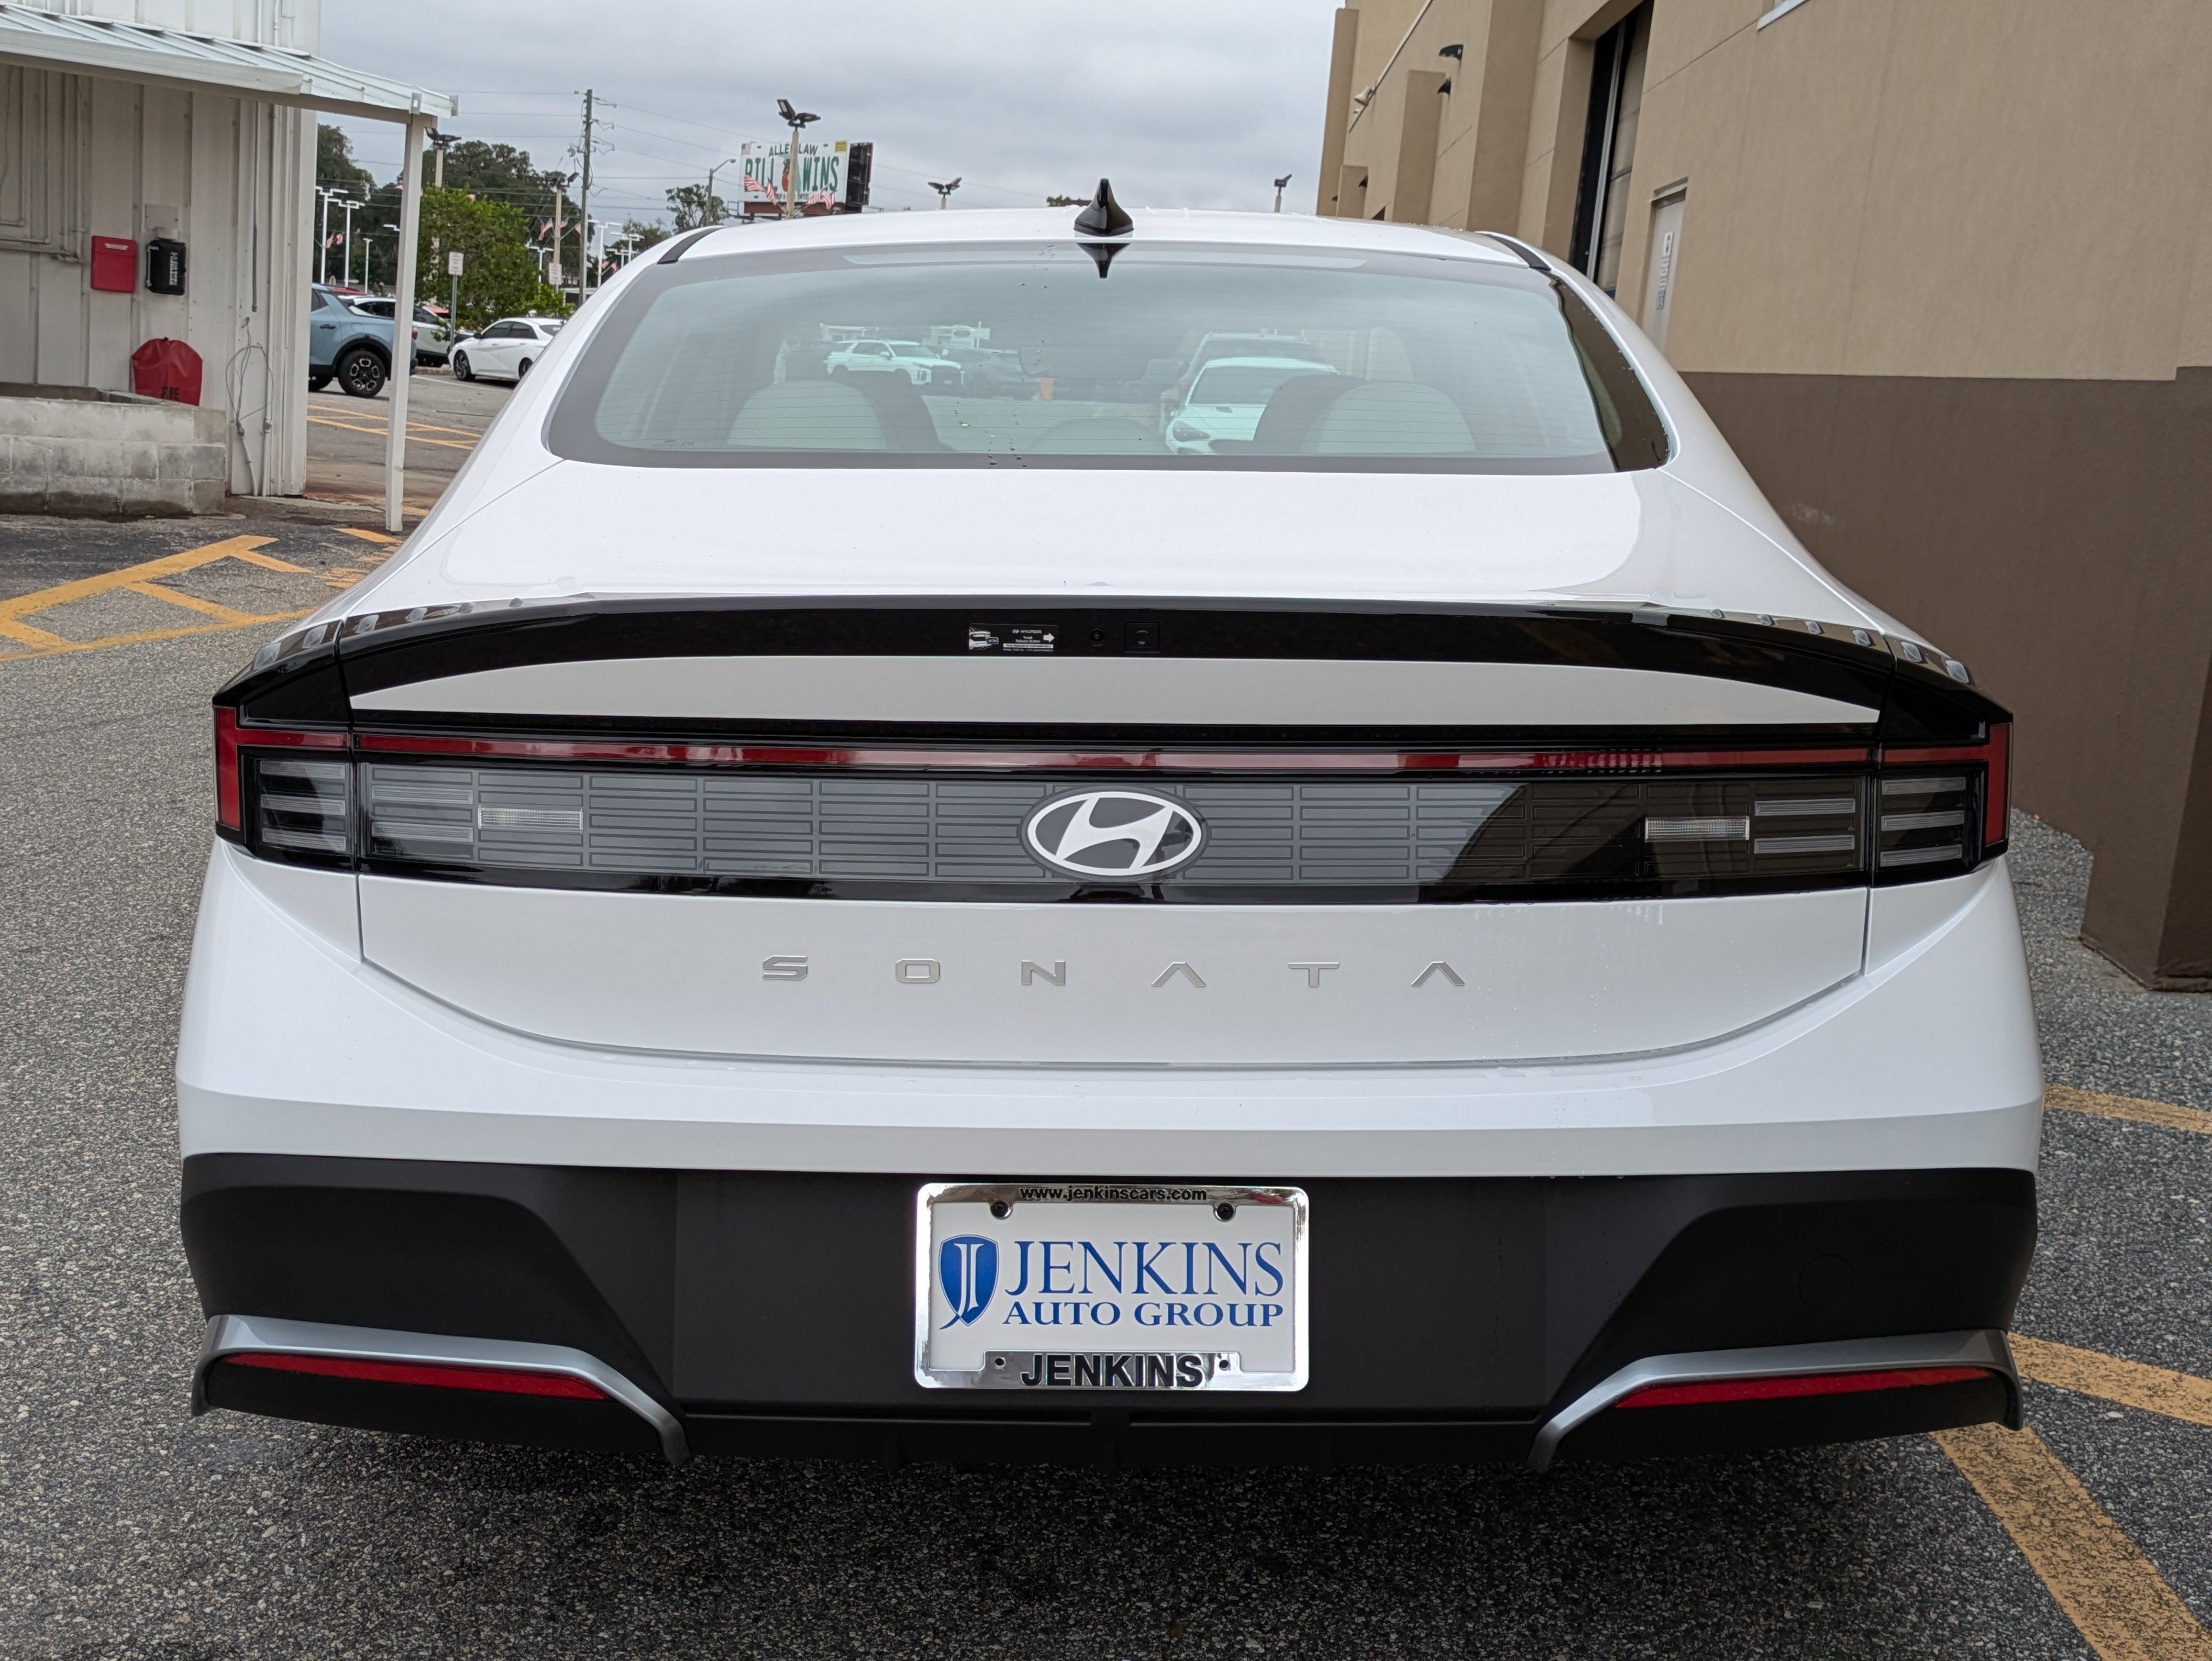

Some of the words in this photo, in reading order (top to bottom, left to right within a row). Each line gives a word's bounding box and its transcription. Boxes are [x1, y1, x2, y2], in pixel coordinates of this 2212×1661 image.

[768, 144, 792, 157] ALLE
[798, 144, 818, 156] LAW
[762, 955, 1466, 987] SONATA
[1020, 1185, 1207, 1201] www.jenkinscars.com
[1005, 1240, 1283, 1296] JENKINS
[1002, 1301, 1121, 1326] AUTO
[1134, 1302, 1283, 1327] GROUP
[1020, 1353, 1205, 1387] JENKINS
